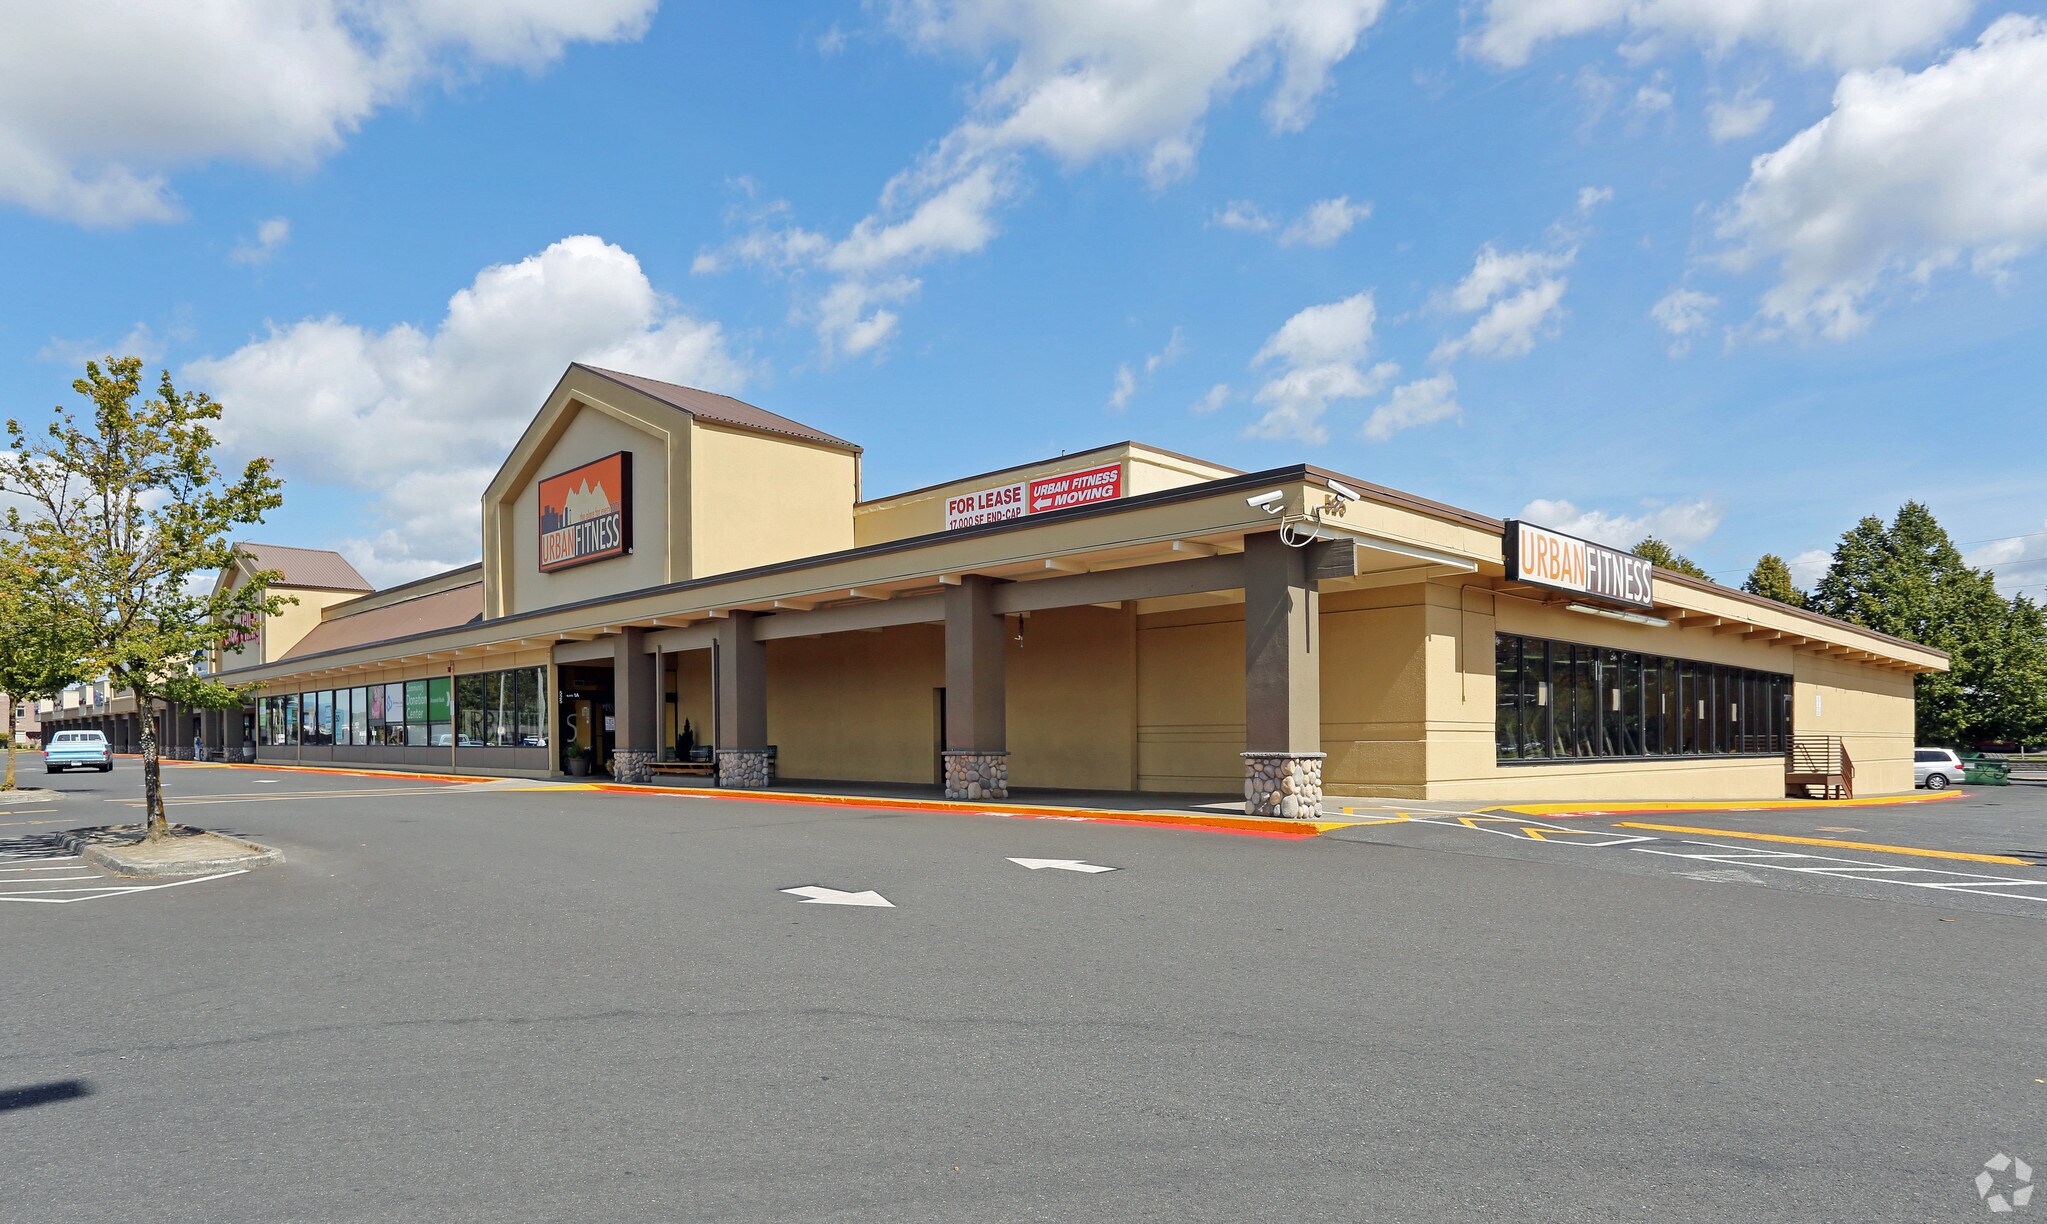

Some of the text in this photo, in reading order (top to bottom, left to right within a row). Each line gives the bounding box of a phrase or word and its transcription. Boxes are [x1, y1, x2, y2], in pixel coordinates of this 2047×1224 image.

[1034, 470, 1118, 498] URBAN FITNESS
[1055, 485, 1114, 506] MOVING
[949, 487, 1022, 516] FOR LEASE
[974, 513, 985, 525] SF
[543, 513, 620, 563] URBAN FITNESS
[1521, 529, 1652, 604] URBAN FITNESS
[406, 694, 427, 706] Donation
[406, 707, 424, 719] Center
